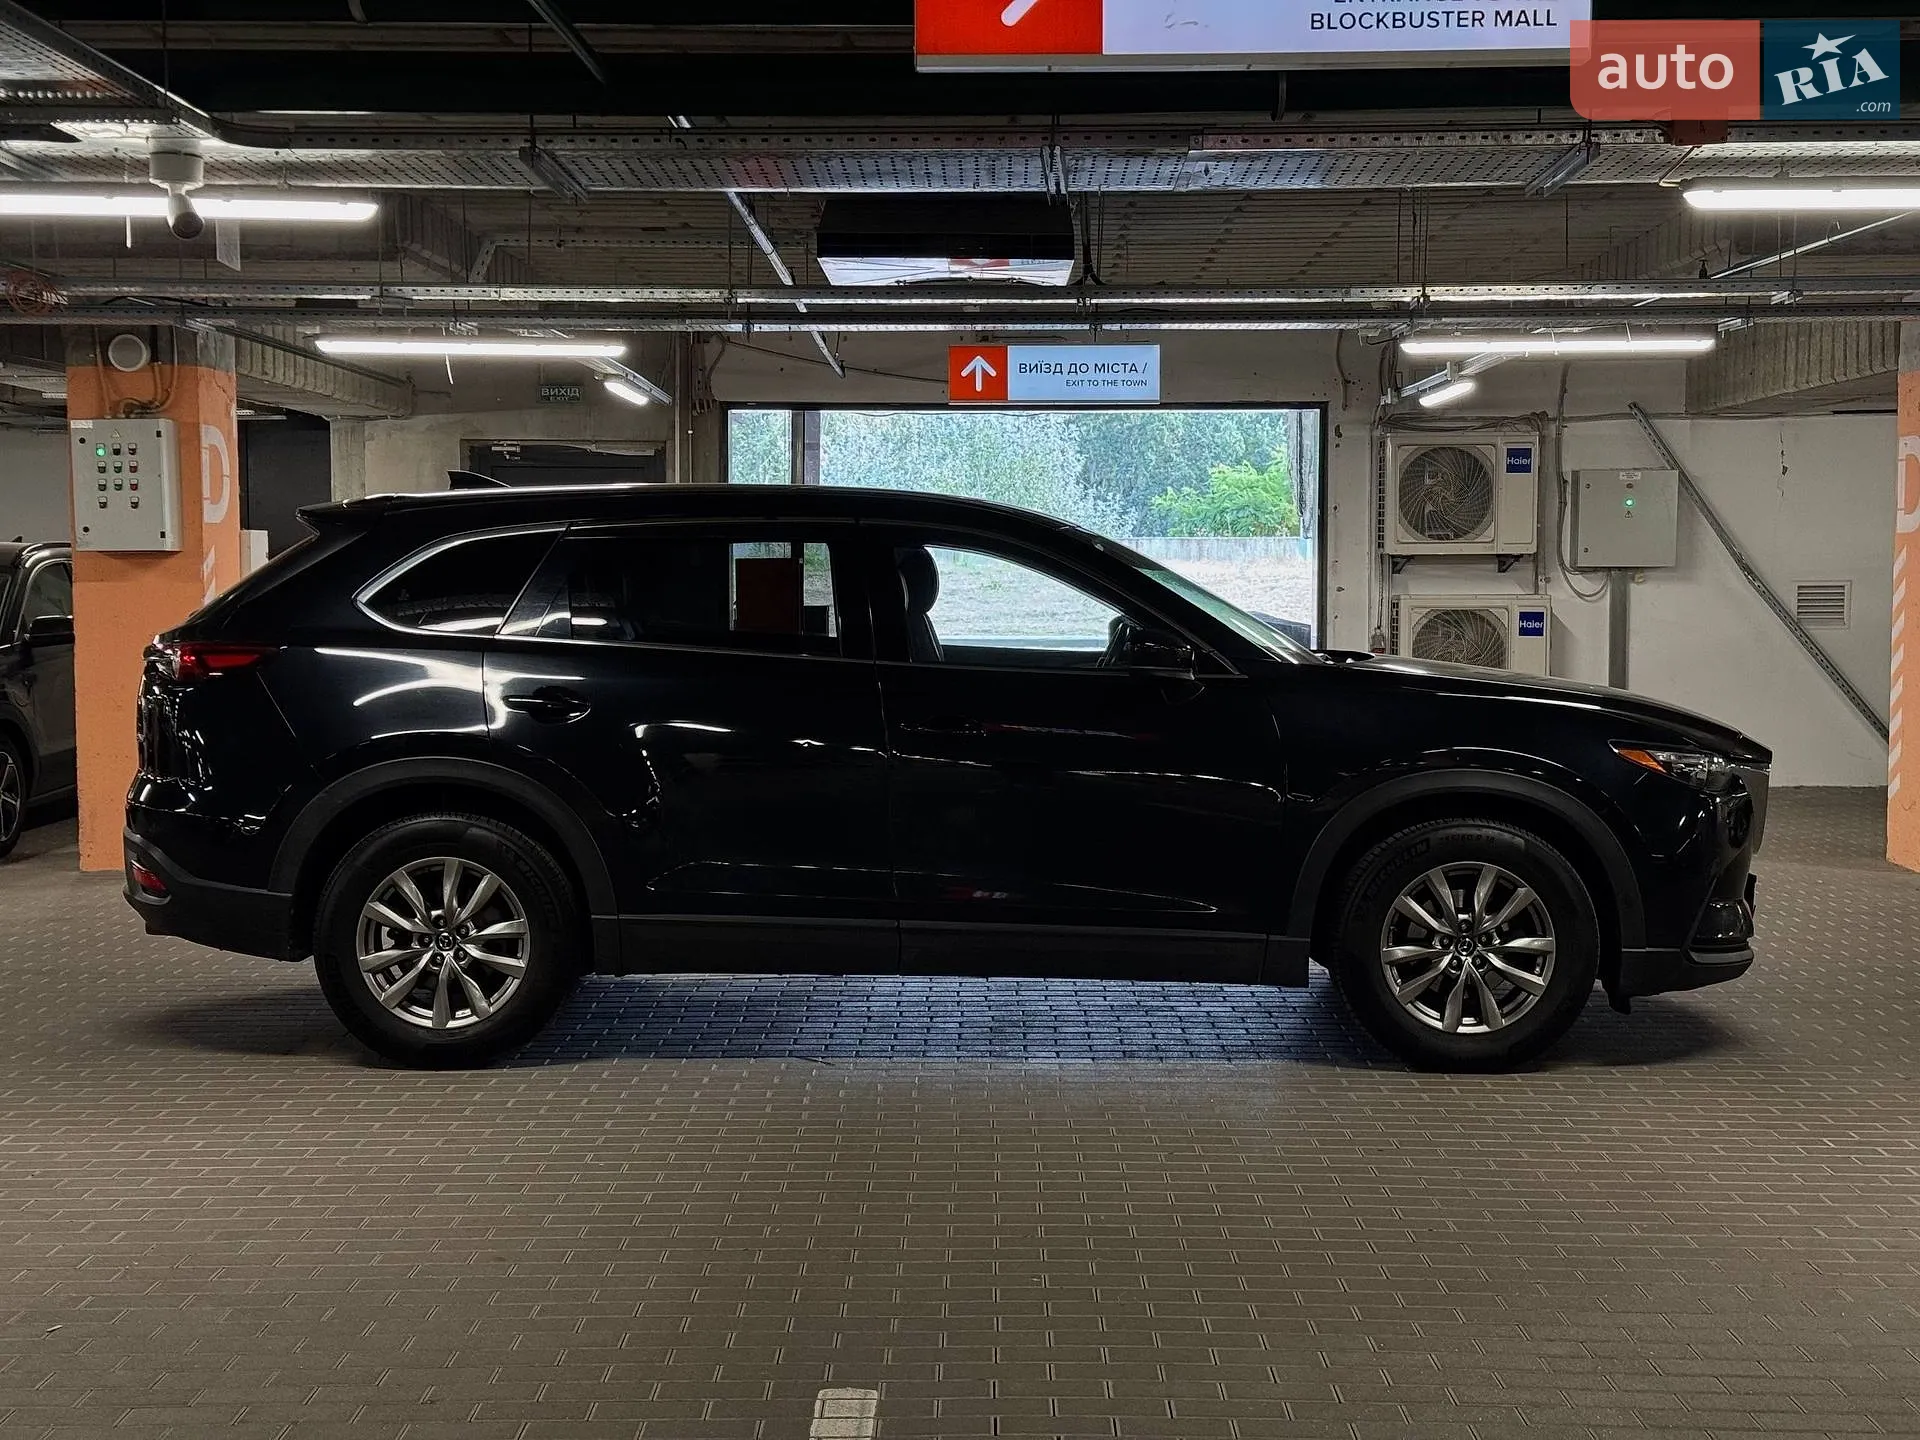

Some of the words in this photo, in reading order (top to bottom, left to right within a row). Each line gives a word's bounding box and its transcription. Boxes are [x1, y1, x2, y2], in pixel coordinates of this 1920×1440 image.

[1310, 11, 1486, 30] BLOCKBUSTER
[1493, 9, 1558, 28] MALL
[1018, 360, 1064, 375] ВИЇЗД
[1067, 362, 1090, 375] ДО
[1094, 362, 1139, 374] МІСТА
[1065, 379, 1085, 387] EXIT
[1087, 379, 1099, 387] TO
[1101, 379, 1119, 387] THE
[1121, 379, 1148, 387] TOWN
[541, 387, 580, 398] ВИХІД
[1506, 456, 1532, 465] Haier
[1519, 619, 1544, 629] Haier
